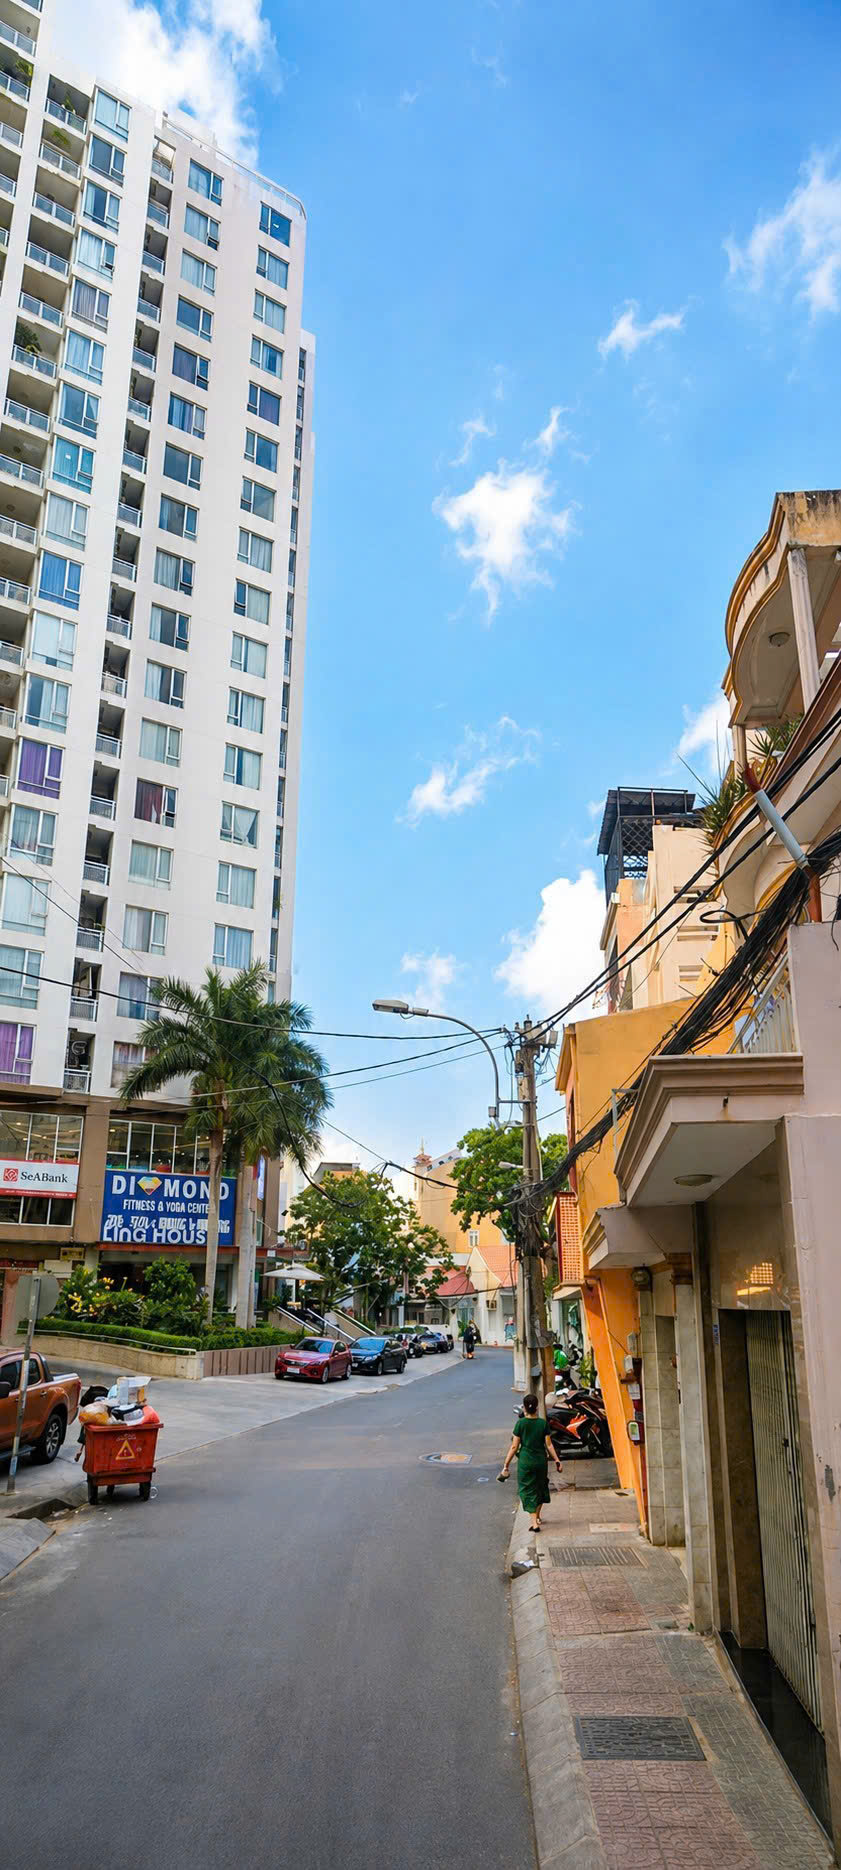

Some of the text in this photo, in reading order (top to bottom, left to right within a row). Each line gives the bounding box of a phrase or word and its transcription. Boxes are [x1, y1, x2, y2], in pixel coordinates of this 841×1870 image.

[20, 1171, 68, 1183] SeABank
[122, 1199, 210, 1214] FITNESS & YOGA CENTE
[152, 1228, 208, 1245] HOUS
